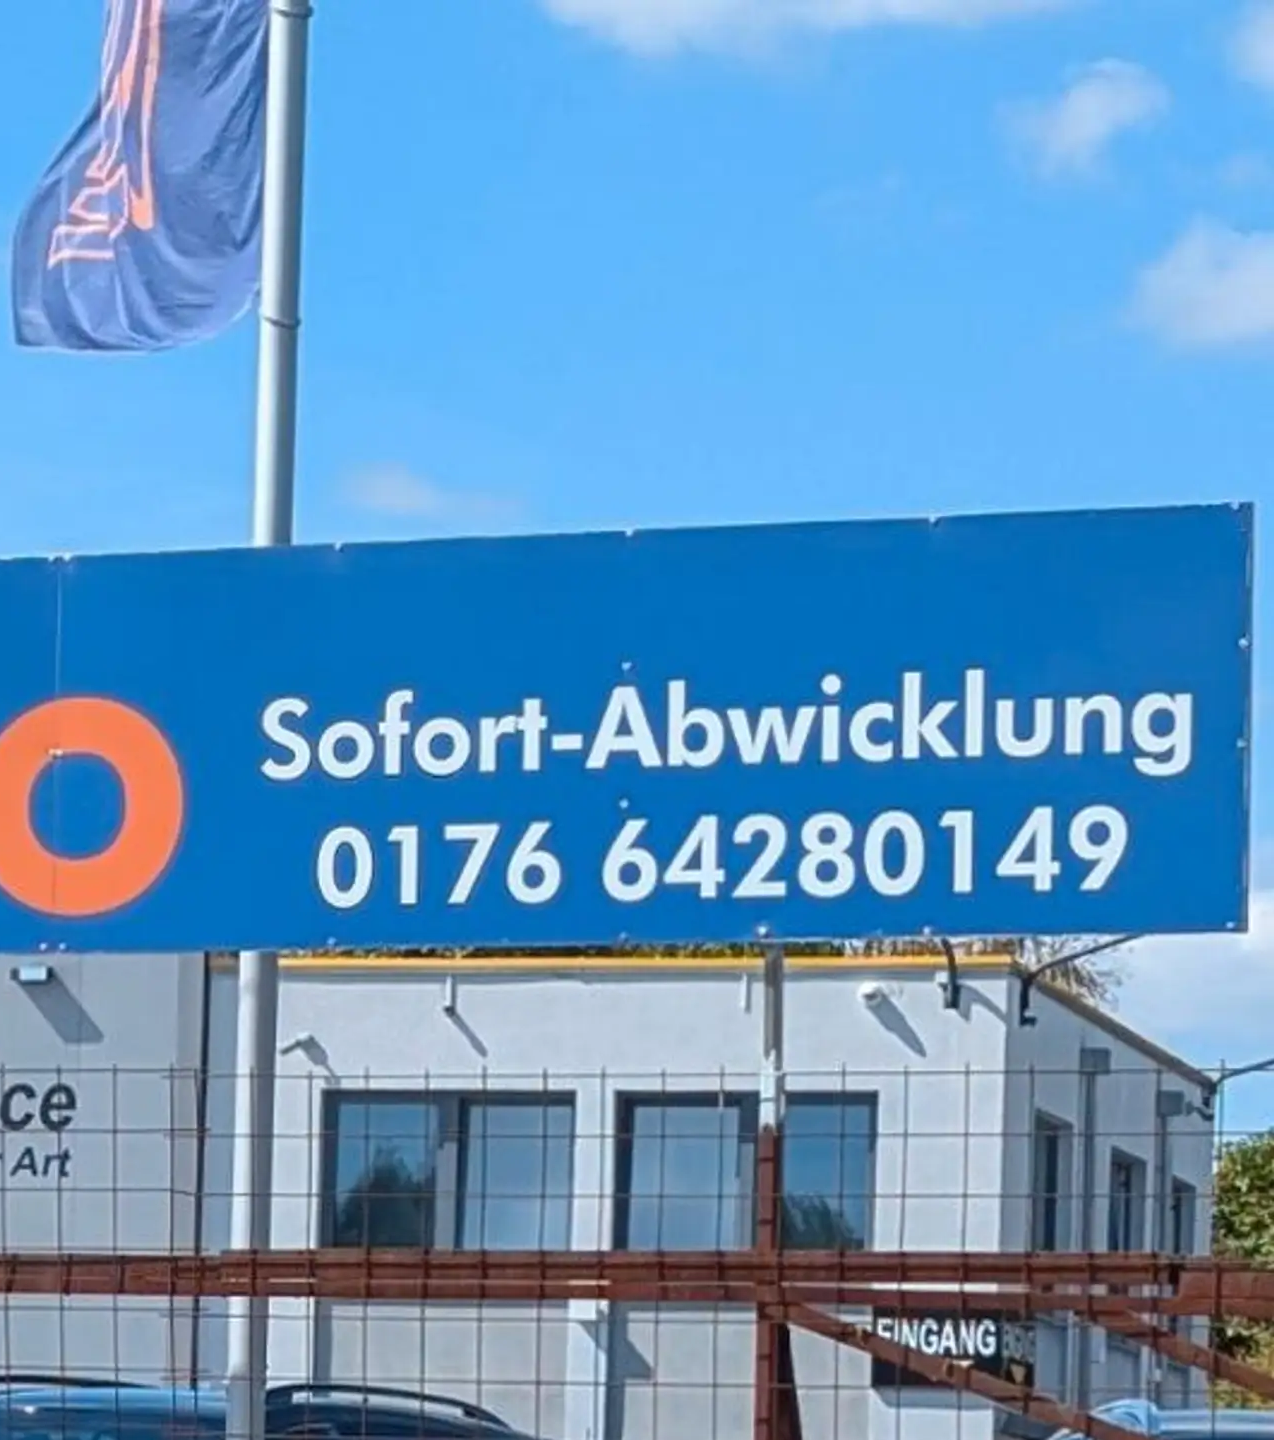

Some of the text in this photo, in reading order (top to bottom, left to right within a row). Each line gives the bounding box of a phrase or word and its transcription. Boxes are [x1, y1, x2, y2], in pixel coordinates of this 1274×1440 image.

[259, 667, 1194, 782] Sofort-Abwicklung
[315, 804, 1130, 910] 0176 64280149
[10, 1145, 73, 1178] Art
[875, 1316, 998, 1358] EINGANG
